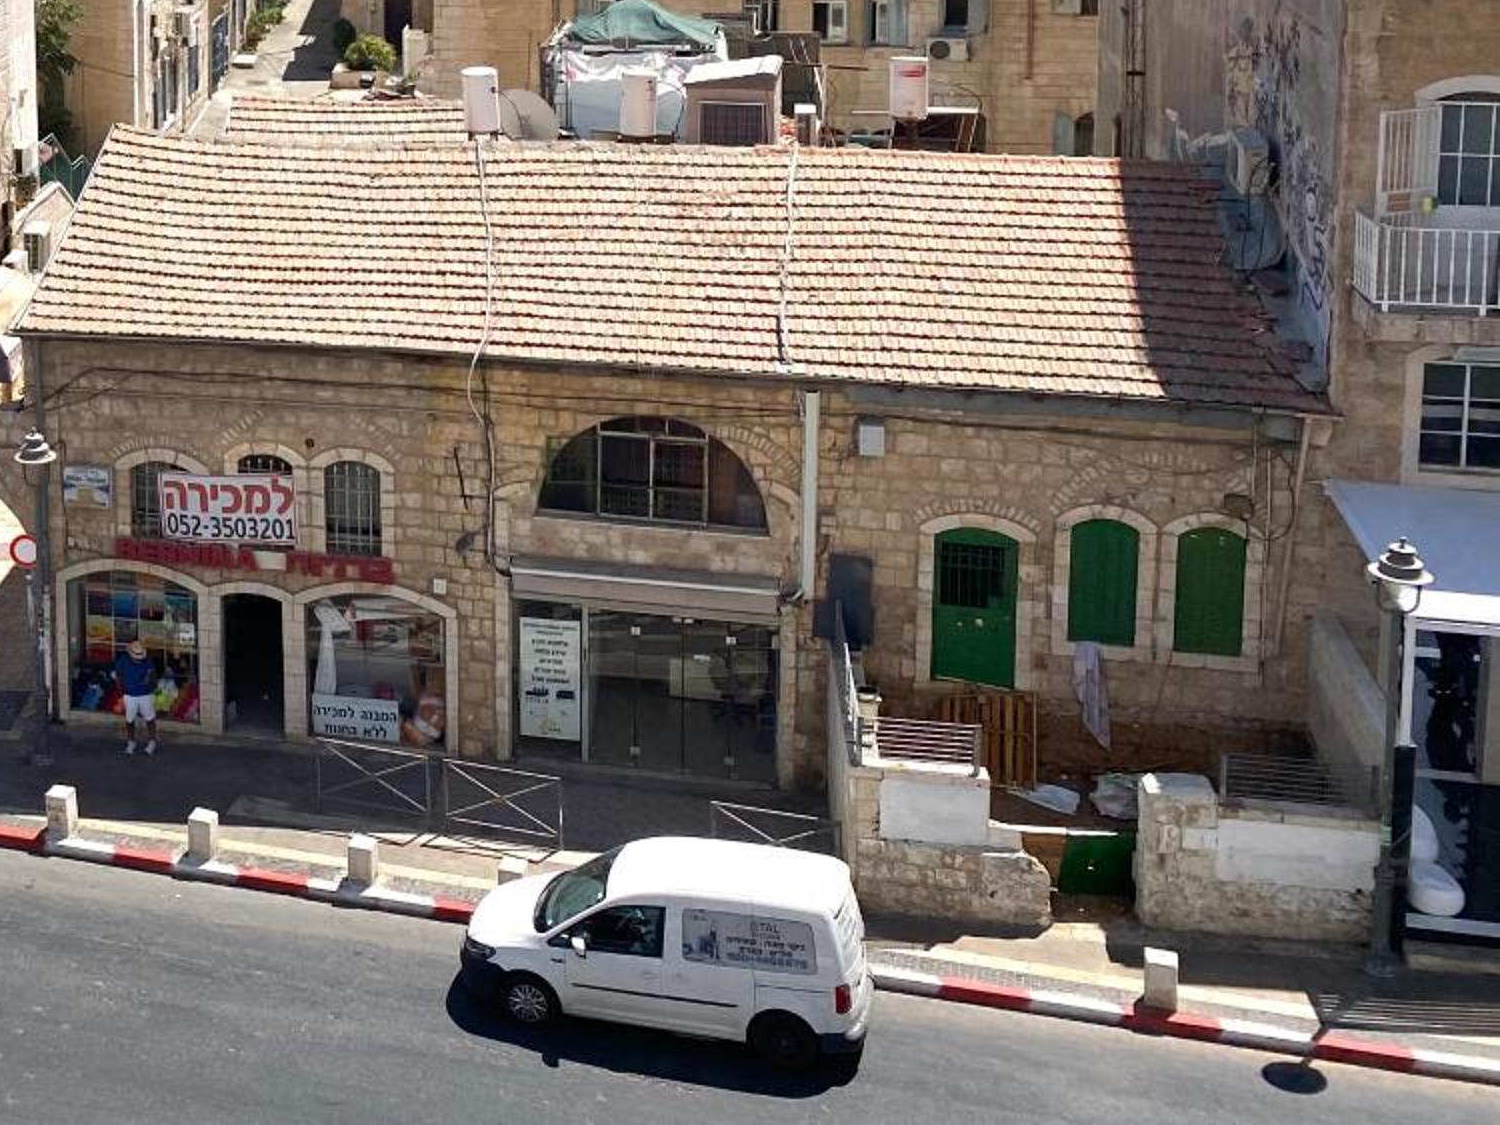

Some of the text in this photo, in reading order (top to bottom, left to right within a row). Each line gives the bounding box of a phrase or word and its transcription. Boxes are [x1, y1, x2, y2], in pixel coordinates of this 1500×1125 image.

[164, 475, 293, 514] למכירה
[167, 513, 294, 539] 052-3503201
[314, 705, 355, 719] למכירה
